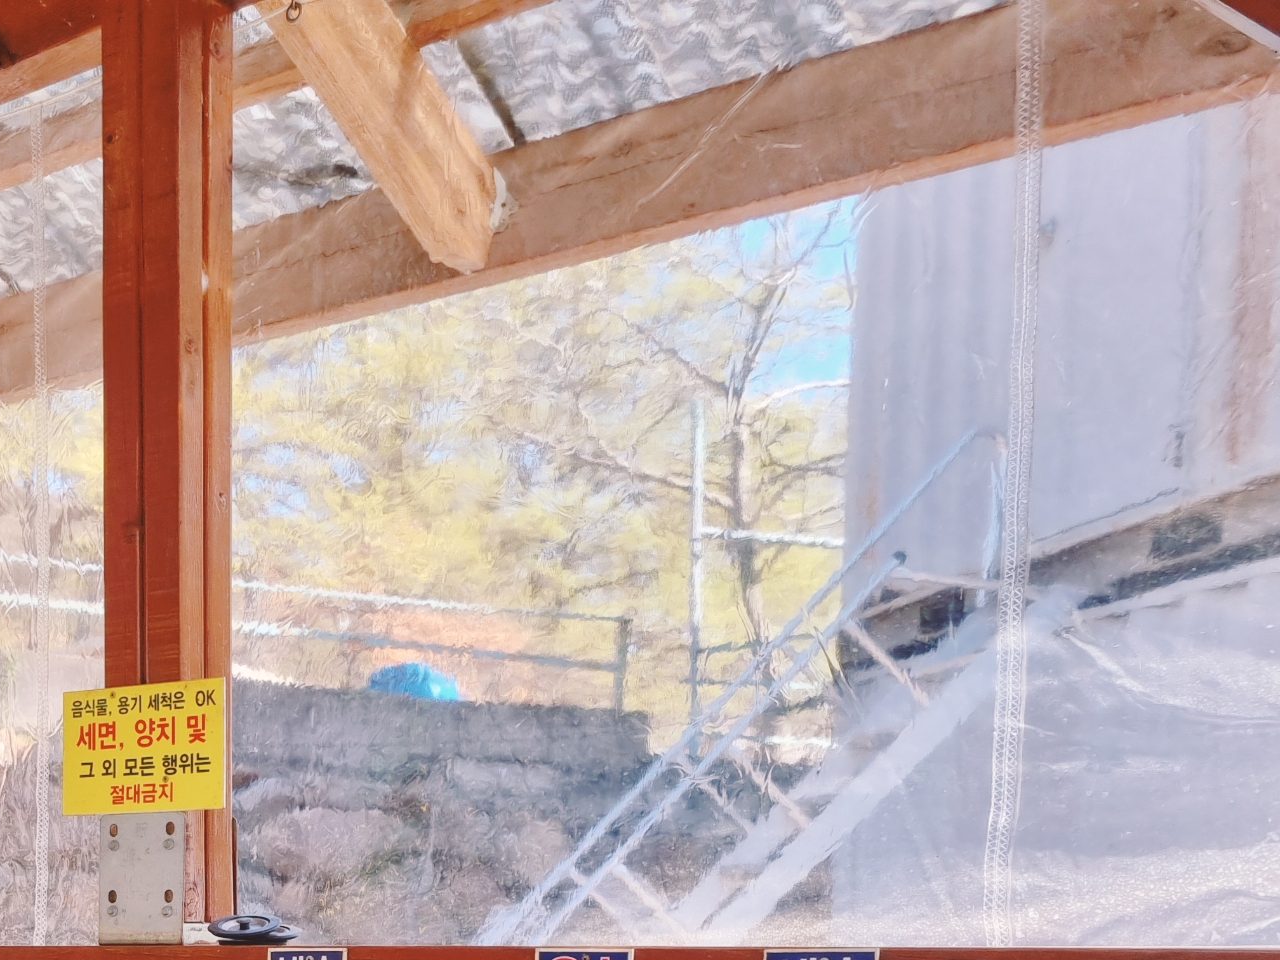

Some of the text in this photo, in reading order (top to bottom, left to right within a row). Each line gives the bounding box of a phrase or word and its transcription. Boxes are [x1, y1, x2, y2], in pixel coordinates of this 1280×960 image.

[71, 689, 216, 718] 음식물, 용기 세척은 OK
[76, 713, 207, 751] 세면, 양치 및
[79, 752, 211, 778] 그 외 모든 행위는
[109, 781, 174, 805] 절대금지
